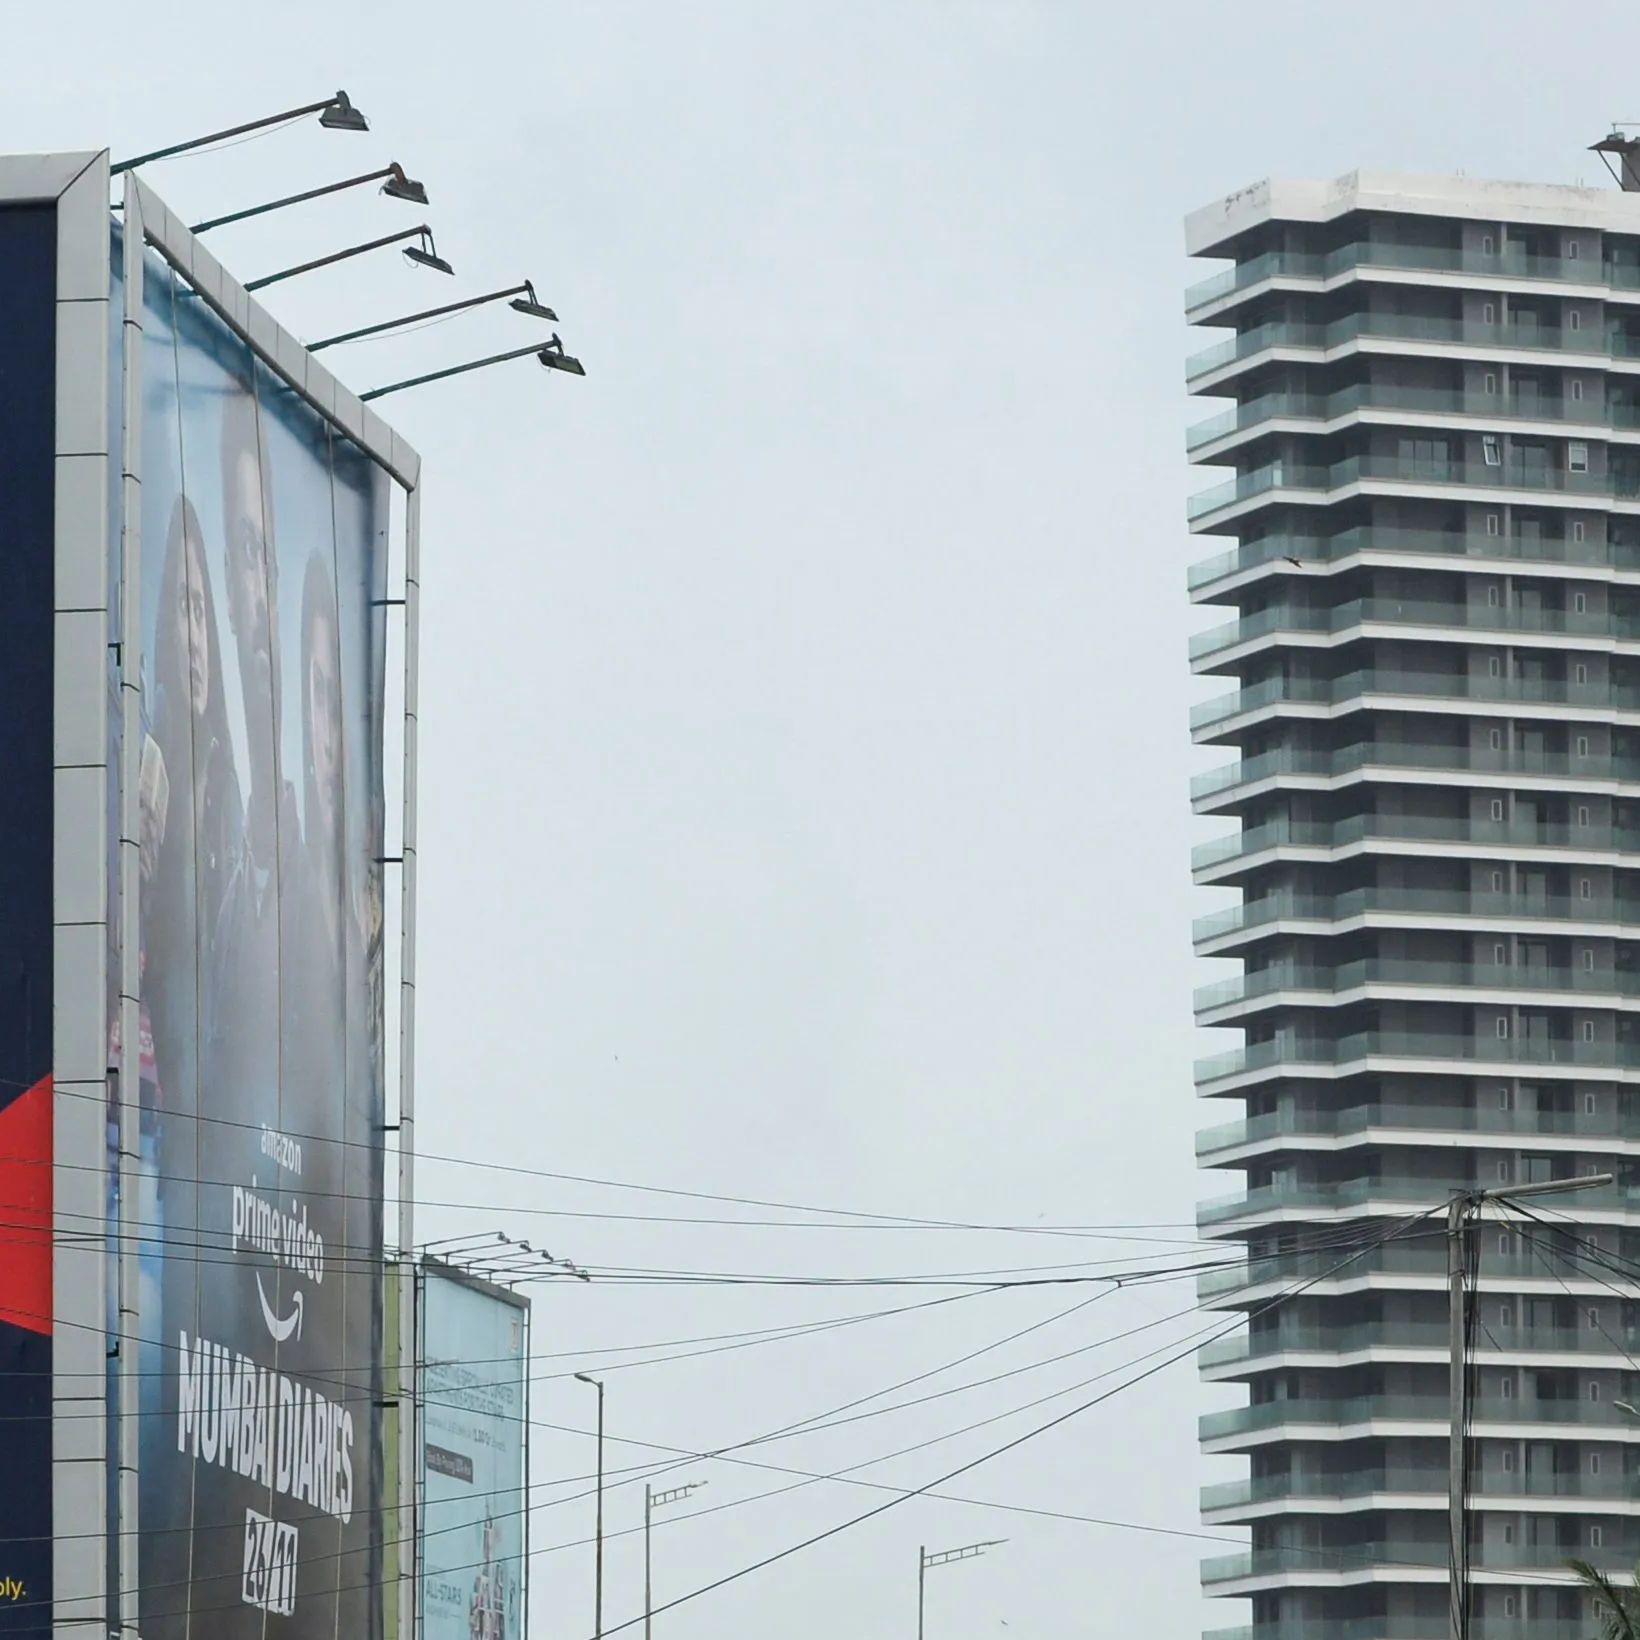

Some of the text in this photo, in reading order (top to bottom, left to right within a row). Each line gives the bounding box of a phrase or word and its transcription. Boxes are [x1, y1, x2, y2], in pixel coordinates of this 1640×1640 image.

[261, 1123, 302, 1175] amazon
[177, 1330, 277, 1489] MUMBAI
[276, 1376, 354, 1524] DIARIES
